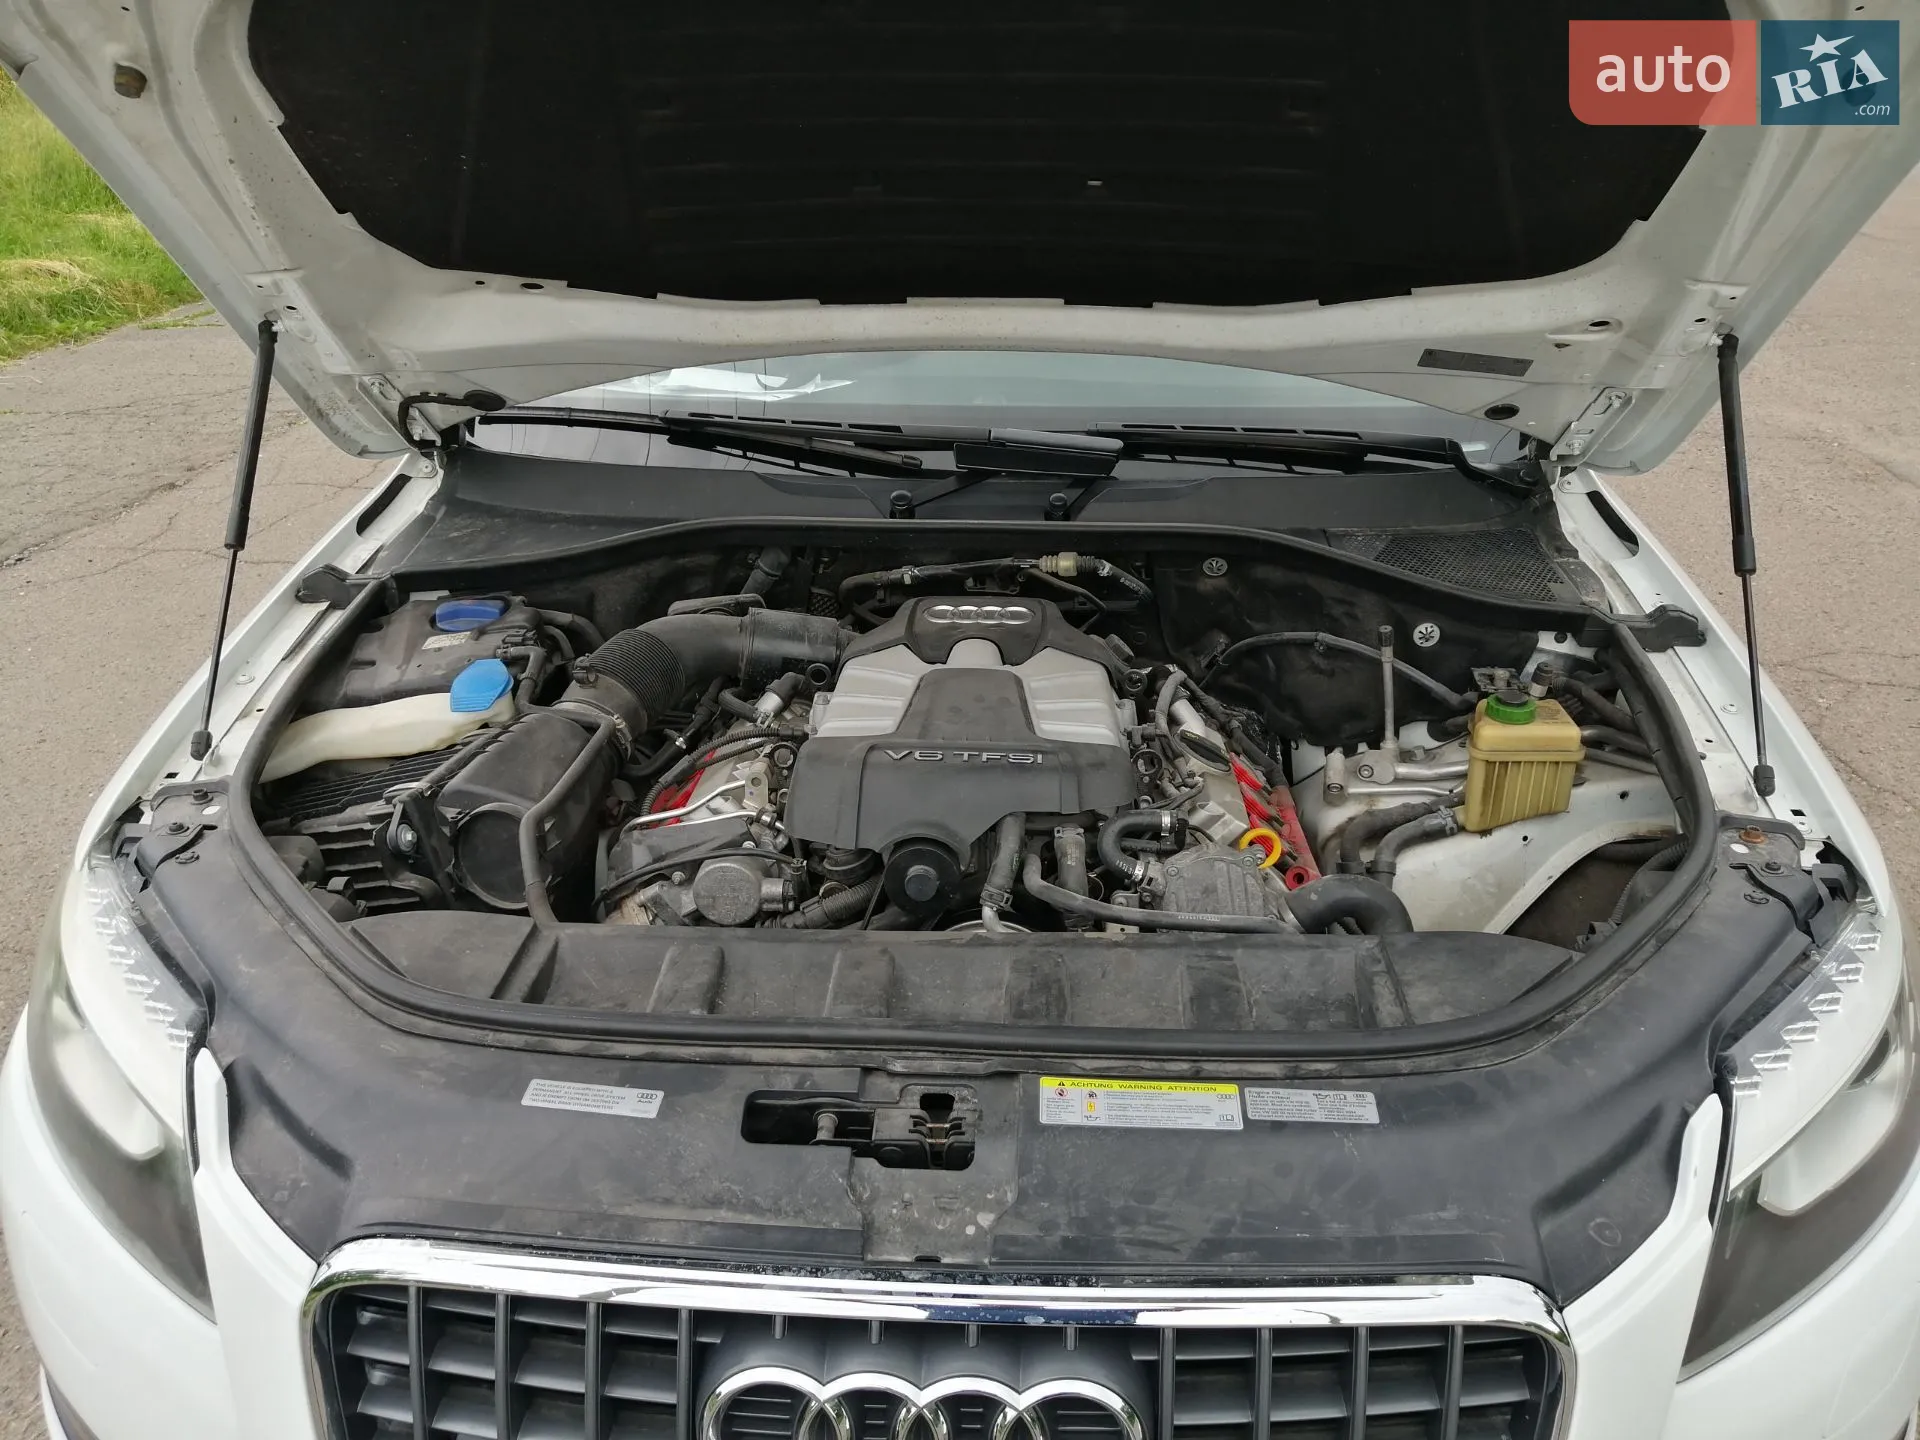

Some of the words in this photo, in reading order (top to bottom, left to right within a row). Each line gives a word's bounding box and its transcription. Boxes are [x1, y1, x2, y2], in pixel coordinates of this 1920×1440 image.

[884, 750, 944, 762] V6
[953, 751, 1043, 765] TFSI
[1070, 1081, 1113, 1089] ACHTUNG
[1118, 1083, 1162, 1091] WARNING
[1167, 1084, 1217, 1092] ATTENTION
